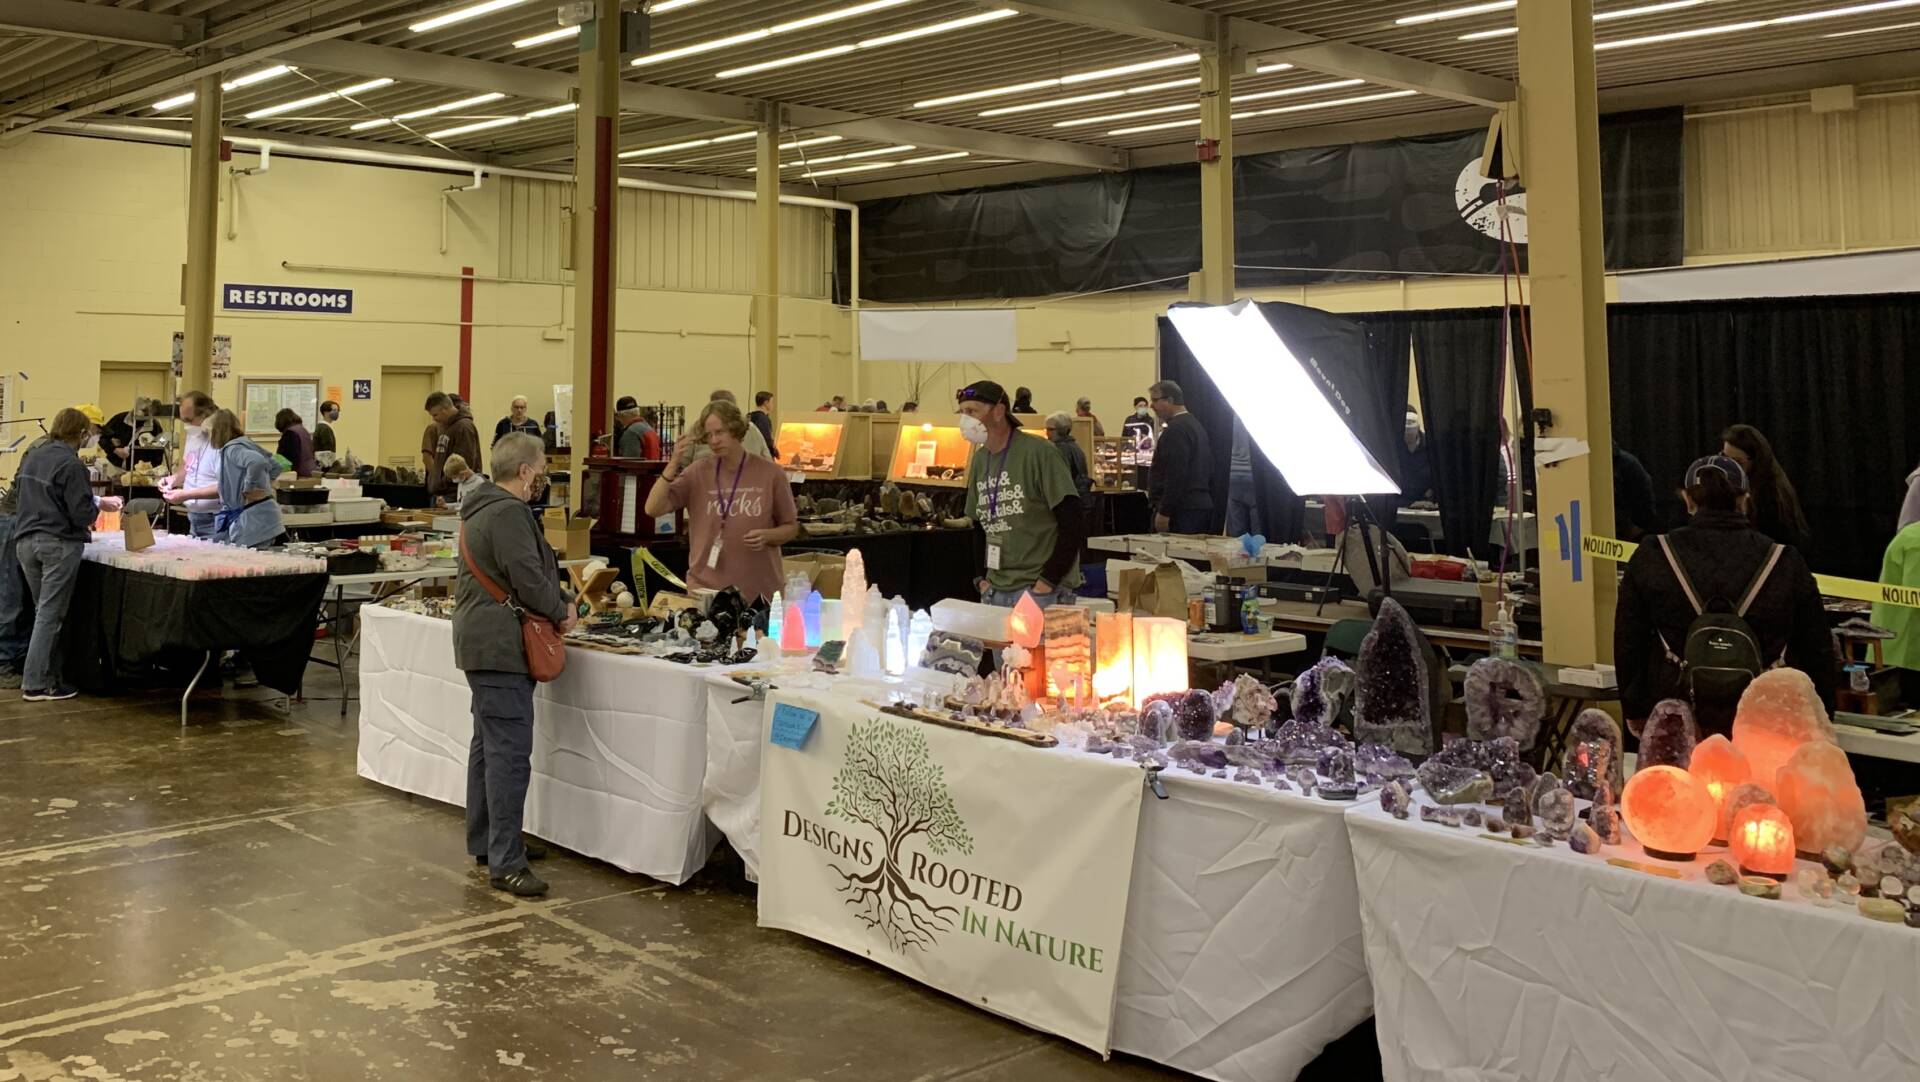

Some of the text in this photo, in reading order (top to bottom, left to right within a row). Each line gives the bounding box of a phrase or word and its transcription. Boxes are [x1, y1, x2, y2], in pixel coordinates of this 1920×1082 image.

[229, 289, 347, 308] RESTROOMS
[706, 491, 762, 517] rocks
[976, 499, 1025, 521] Crytals&
[1583, 536, 1624, 558] CAUTION
[1882, 587, 1920, 606] UTION
[783, 810, 1023, 912] DESIGNS ROOTED
[961, 905, 1104, 973] IN NATURE
